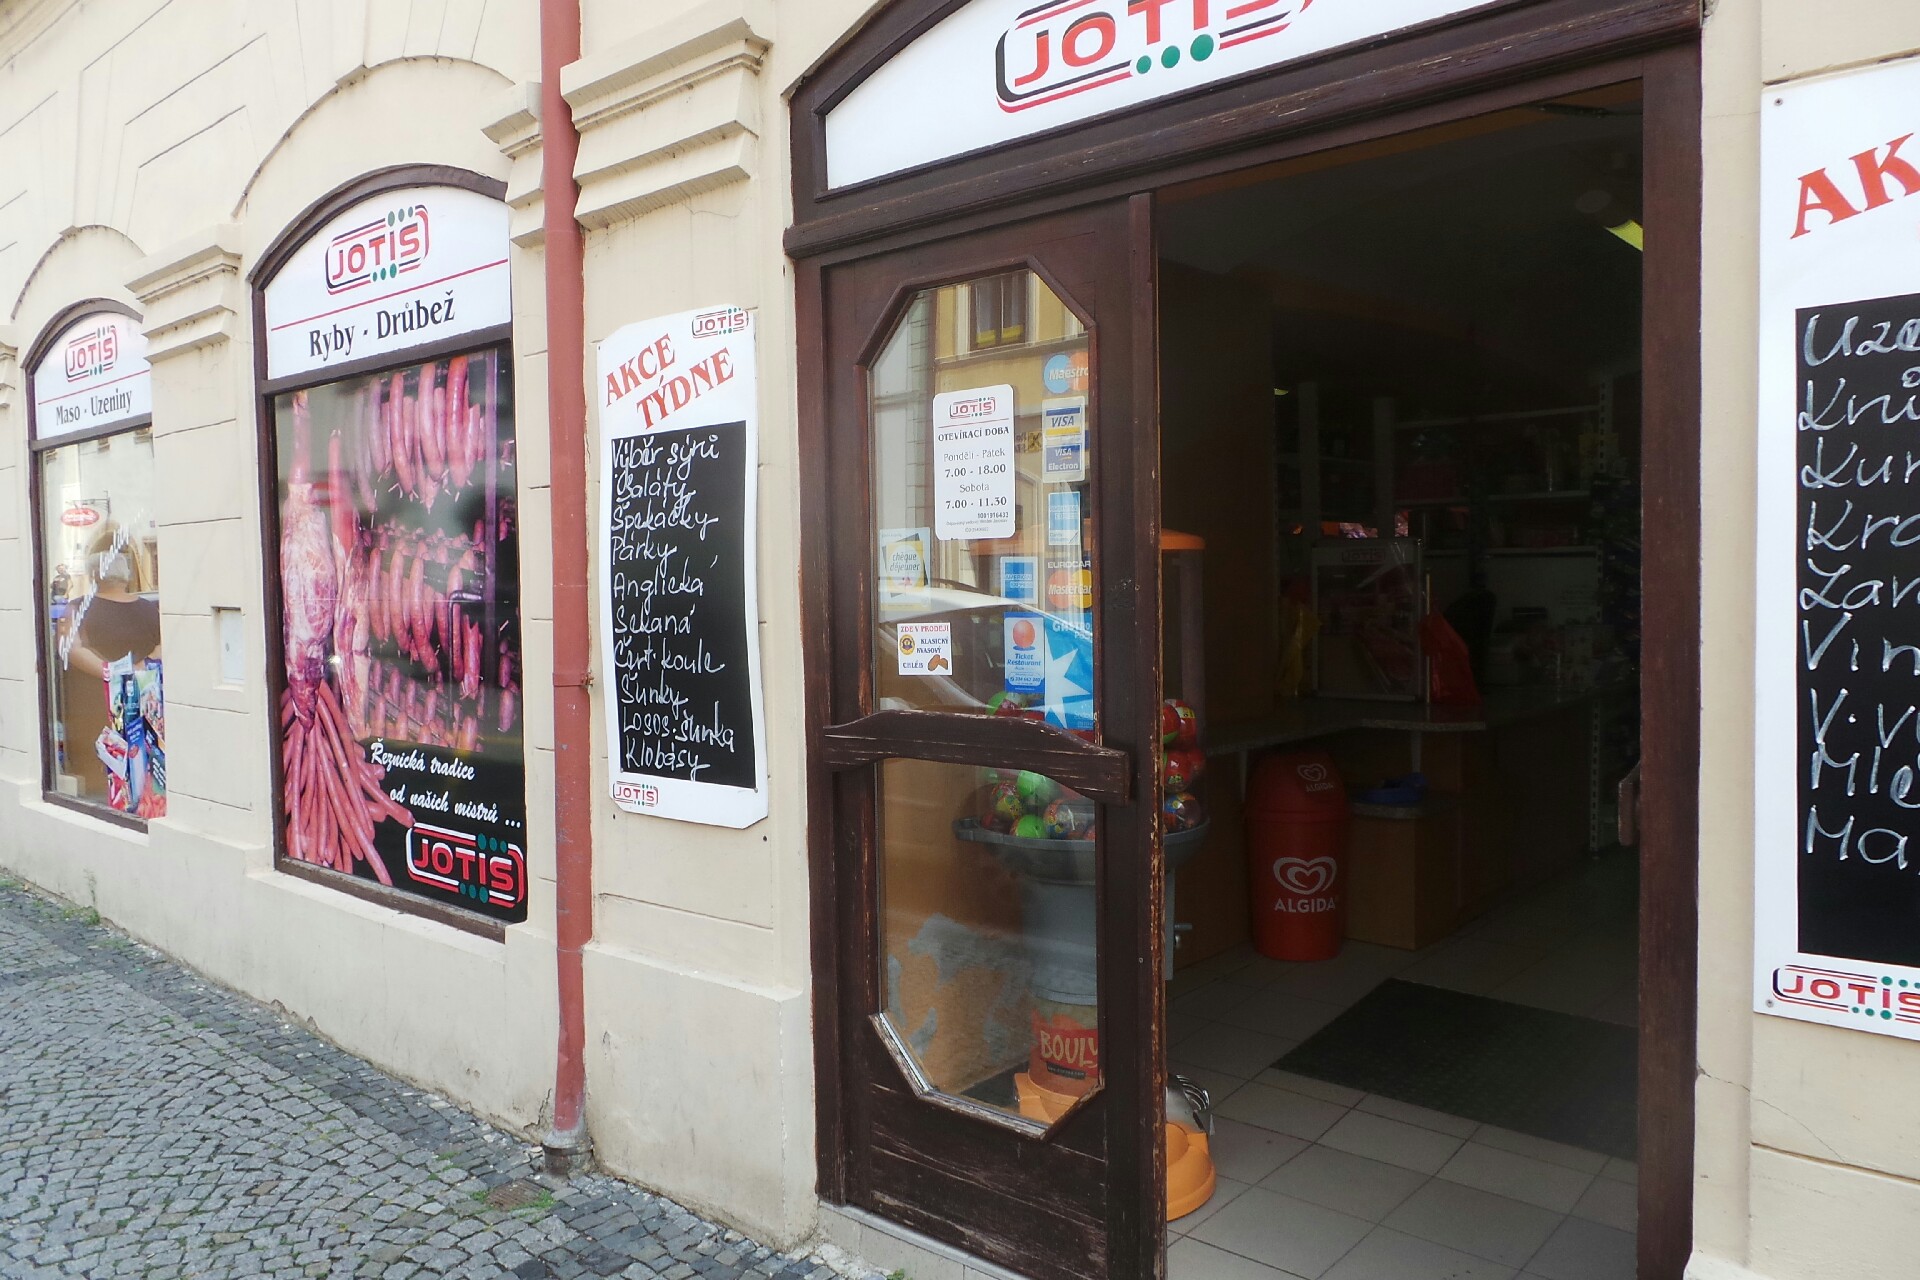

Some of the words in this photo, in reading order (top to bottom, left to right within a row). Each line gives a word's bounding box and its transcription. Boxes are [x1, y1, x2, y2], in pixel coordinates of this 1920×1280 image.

[332, 222, 420, 281] JOTIS
[309, 323, 355, 361] Ryby
[376, 289, 456, 340] Drůbež
[696, 312, 744, 333] JOTIS
[69, 337, 114, 372] JOTIS
[606, 332, 675, 408] AKCE
[636, 347, 734, 430] TÝDNE
[56, 404, 80, 426] Maso
[90, 387, 132, 416] Uzeniny
[952, 401, 992, 415] JOTIS
[1051, 416, 1074, 428] VISA
[938, 427, 982, 442] OTEVÍRACÍ
[985, 426, 1009, 437] DOBA
[1048, 462, 1079, 471] Electron
[1055, 448, 1072, 457] VISA
[945, 467, 966, 478] 7.00
[978, 464, 1006, 475] 18.00
[960, 484, 989, 493] Sobota
[946, 499, 967, 509] 7.00
[979, 497, 1007, 508] 11.30
[612, 530, 677, 578] Párky
[890, 563, 920, 573] déjeuner
[892, 552, 917, 563] chèque
[1048, 560, 1091, 569] EUROCAR
[613, 555, 718, 614] Anglická
[661, 637, 725, 673] koule
[621, 670, 688, 720] Šunky
[371, 738, 426, 772] Řeznická
[430, 757, 475, 780] tradice
[626, 735, 711, 781] Klobásy
[1811, 742, 1920, 808] Mle
[390, 784, 405, 801] od
[410, 790, 449, 812] našich
[454, 801, 498, 824] mistrů
[615, 787, 655, 802] JOTIS
[1306, 782, 1334, 792] ALGIDA
[1806, 804, 1920, 871] Ma
[414, 838, 514, 891] JOTIS
[1274, 898, 1336, 913] ALGIDA
[1783, 975, 1920, 1014] JOTIS
